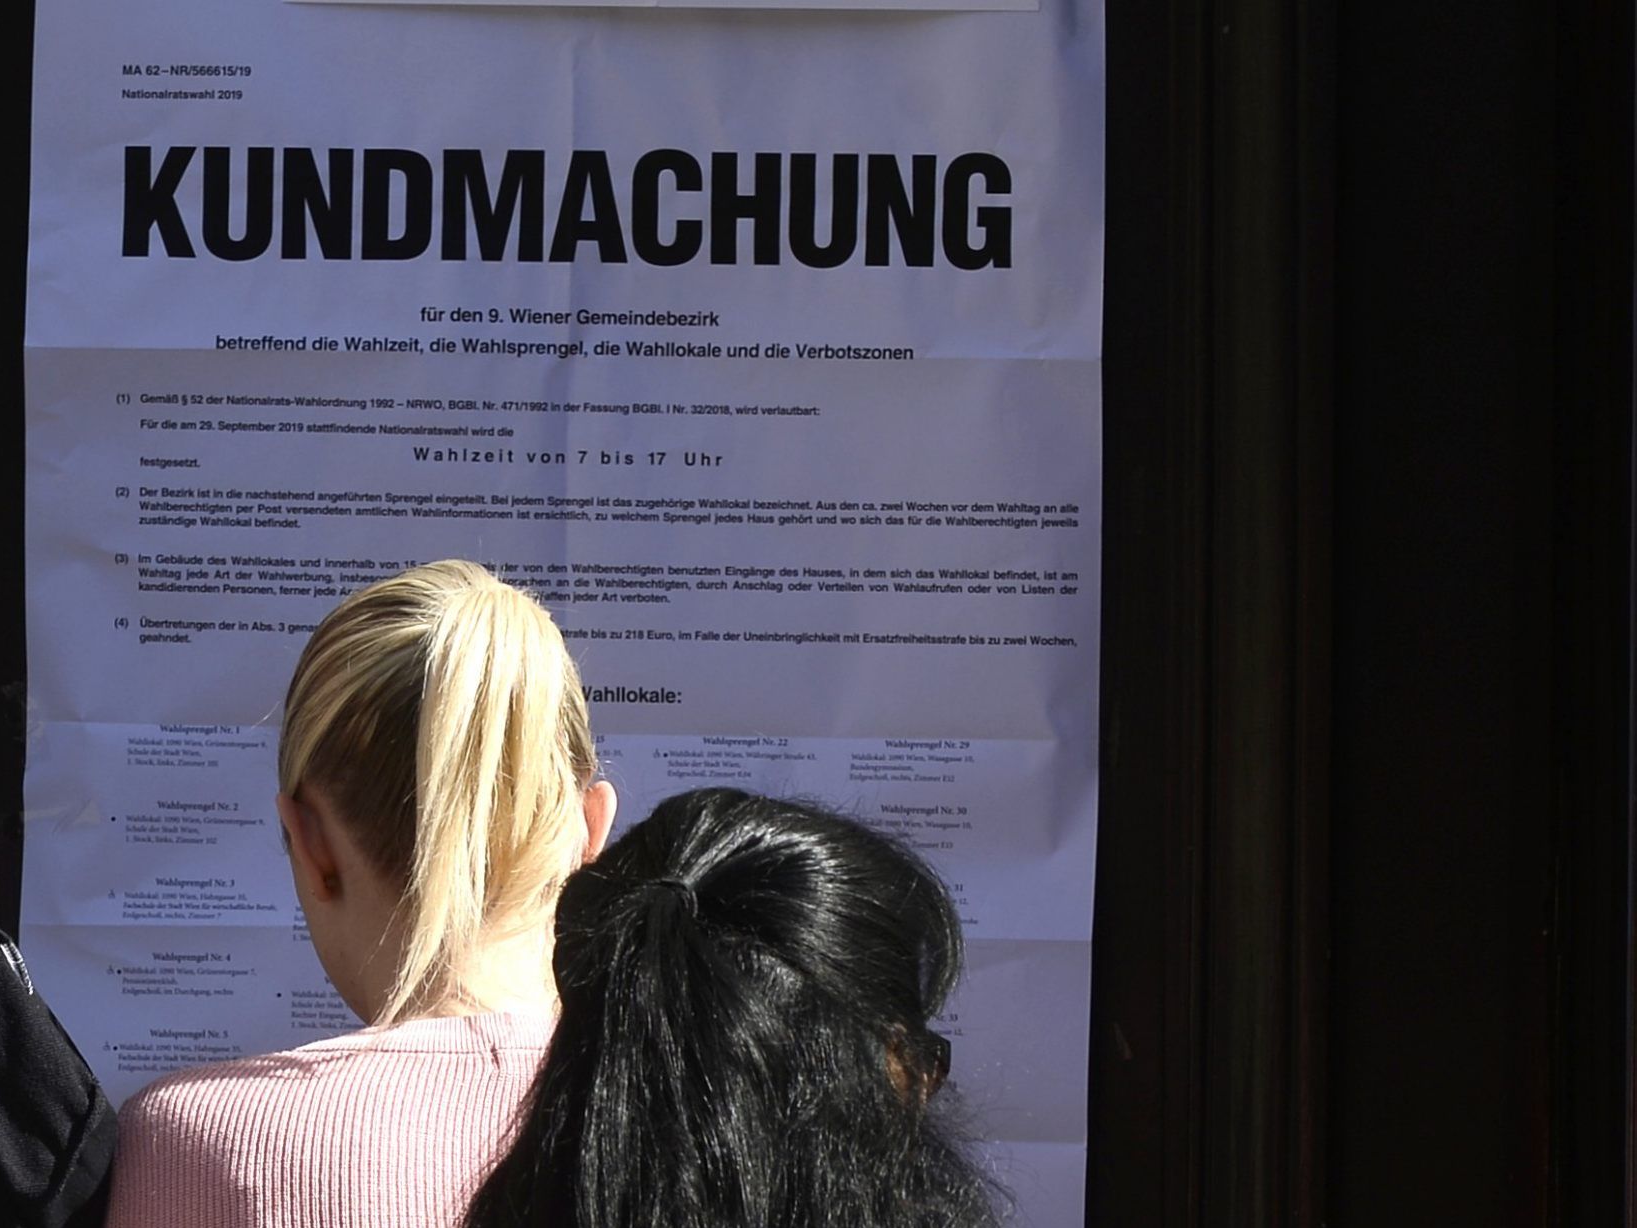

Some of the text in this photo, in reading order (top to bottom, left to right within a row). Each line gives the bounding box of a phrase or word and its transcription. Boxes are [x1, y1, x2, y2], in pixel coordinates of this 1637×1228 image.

[123, 64, 141, 75] MA
[122, 88, 242, 100] Nationalratswahl 2019
[121, 144, 1012, 270] KUNDMACHUNG
[421, 306, 718, 327] für den 9. Wiener Gemeindebezirk
[216, 334, 913, 360] betreffend die Wahlzeit, die Wahlsprengel, die Wahllokale und die Verbotszonen
[116, 393, 130, 405] (1)
[206, 394, 223, 405] der
[226, 395, 367, 409] Nationalrats-Wahlordnung
[371, 398, 394, 409] 1992
[406, 398, 446, 410] NRWO,
[482, 400, 499, 410] Nr.
[501, 400, 548, 412] 471/1992
[563, 402, 580, 412] der
[583, 402, 630, 415] Fassung
[672, 404, 688, 414] Nr.
[691, 404, 733, 416] 32/2018,
[736, 405, 758, 416] wird
[140, 418, 513, 437] Für die am 29. September 2019 stattfindende Nationalratswahl wird die
[413, 446, 723, 467] Wahlzeit von 7 bis 17 Uhr
[116, 485, 129, 499] (2)
[139, 486, 158, 497] Der
[161, 487, 195, 498] Bezirk
[197, 487, 210, 499] ist
[226, 488, 242, 499] die
[245, 489, 315, 501] nachstehend
[317, 491, 382, 504] angeführten
[385, 492, 433, 506] Sprengel
[491, 494, 509, 506] Bei
[511, 495, 544, 508] jedem
[547, 495, 594, 509] Sprengel
[597, 497, 610, 507] ist
[613, 497, 632, 507] das
[635, 497, 695, 511] zugehörige
[698, 498, 750, 509] Wahllokal
[753, 499, 814, 510] bezeichnet.
[816, 500, 837, 511] Aus
[839, 500, 859, 511] den
[880, 500, 903, 512] zwei
[906, 501, 948, 512] Wochen
[951, 503, 967, 513] vor
[971, 502, 994, 513] dem
[997, 502, 1041, 516] Wahltag
[1044, 504, 1057, 514] an
[1060, 503, 1078, 514] alle
[139, 514, 301, 529] zuständige Wahllokal befindet.
[115, 616, 128, 630] (4)
[140, 617, 216, 632] Übertretungen
[218, 620, 235, 631] der
[252, 621, 277, 632] Abs.
[139, 632, 192, 645] geahndet.
[591, 628, 607, 639] bis
[647, 629, 675, 641] Euro,
[678, 630, 692, 640] im
[695, 630, 720, 641] Falle
[723, 631, 740, 641] der
[743, 631, 840, 644] Uneinbringlichkeit
[843, 633, 860, 643] mit
[863, 632, 966, 645] Ersatzfreiheitsstrafe
[969, 635, 985, 645] bis
[1004, 635, 1027, 646] zwei
[160, 723, 218, 736] Wahlsprengel
[220, 725, 233, 734] Nr.
[703, 736, 760, 748] Wahlsprengel
[886, 739, 942, 751] Wahlsprengel
[944, 740, 957, 749] Nr.
[158, 800, 215, 813] Wahlsprengel
[217, 801, 232, 812] Nr.
[153, 951, 209, 964] Wahlsprengel
[211, 952, 224, 962] Nr.
